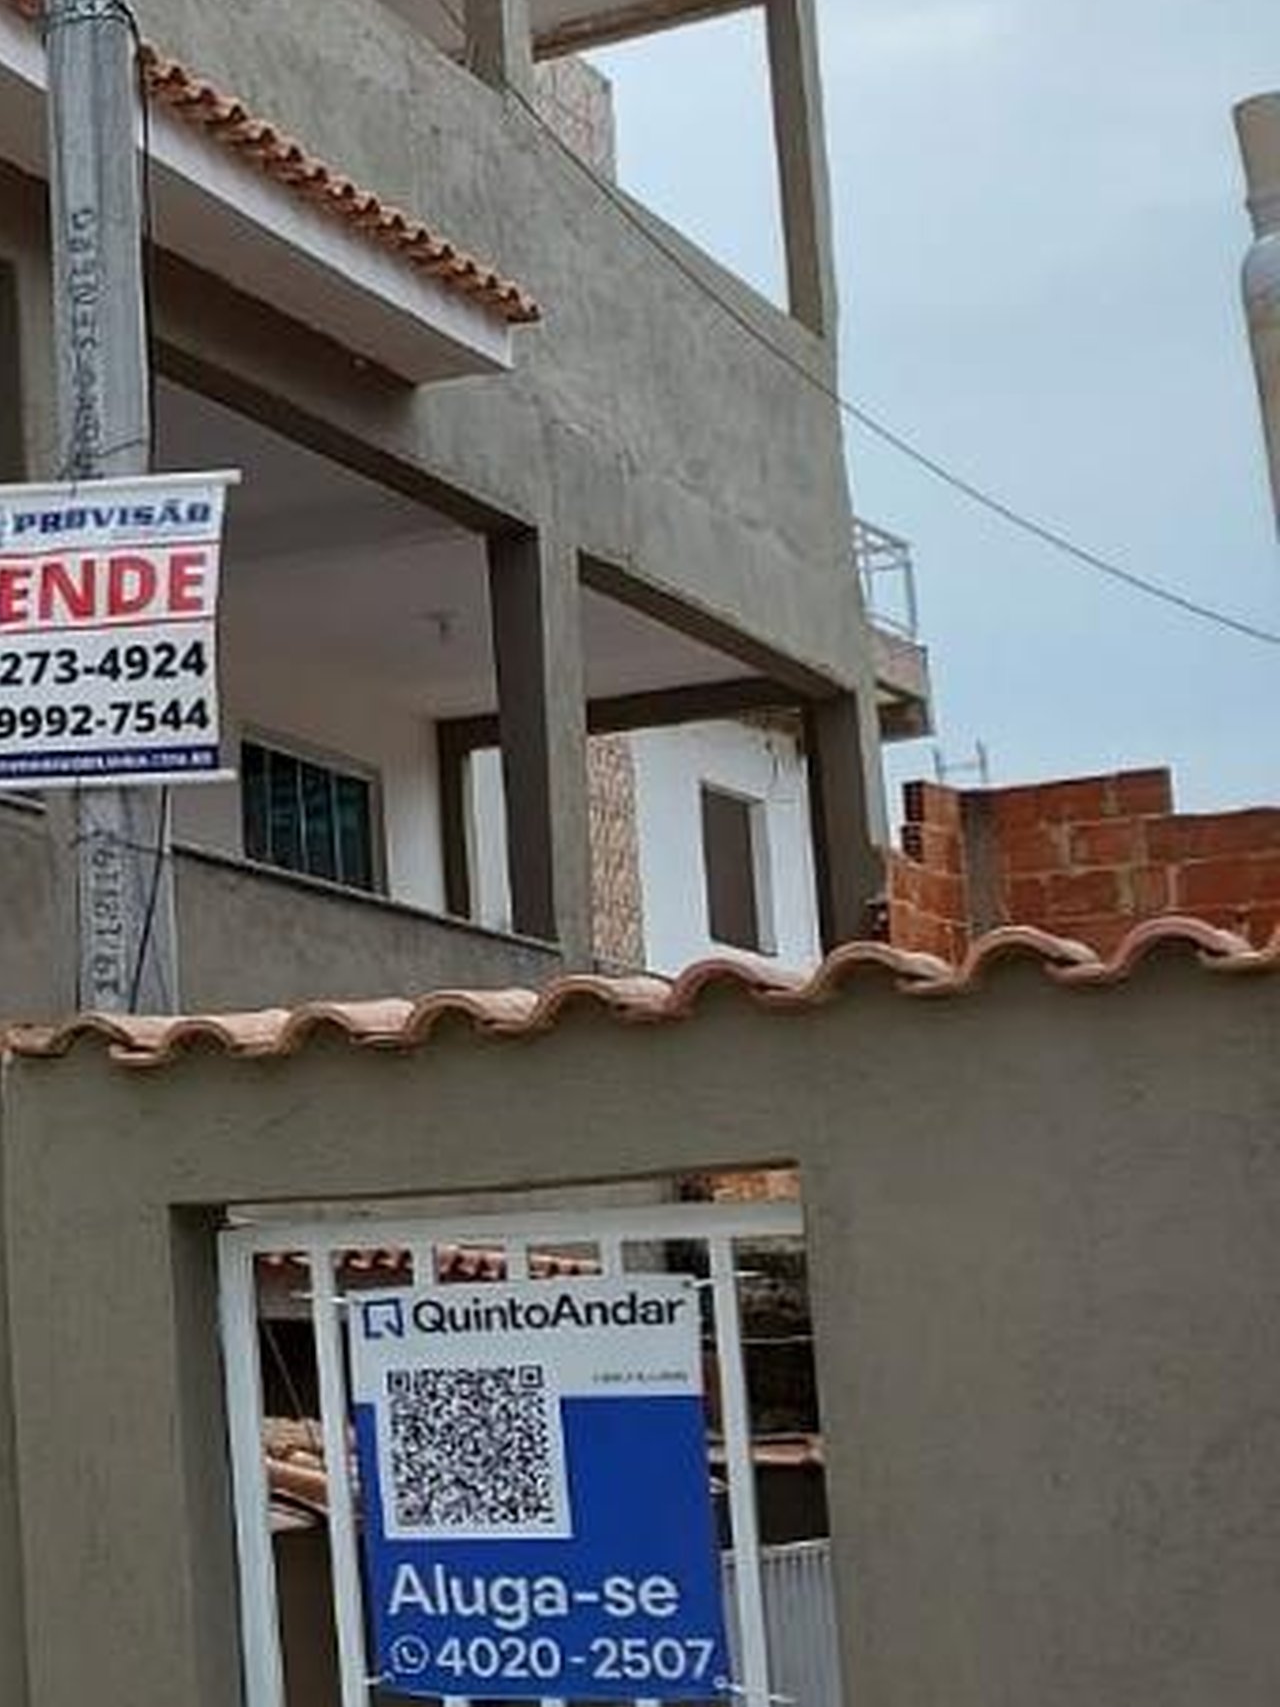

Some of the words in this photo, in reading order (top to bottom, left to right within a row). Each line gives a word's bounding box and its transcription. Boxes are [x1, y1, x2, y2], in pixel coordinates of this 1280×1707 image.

[12, 500, 212, 535] PROVISÃO
[410, 1292, 686, 1335] QuintoAndar
[387, 1563, 680, 1629] Aluga-se
